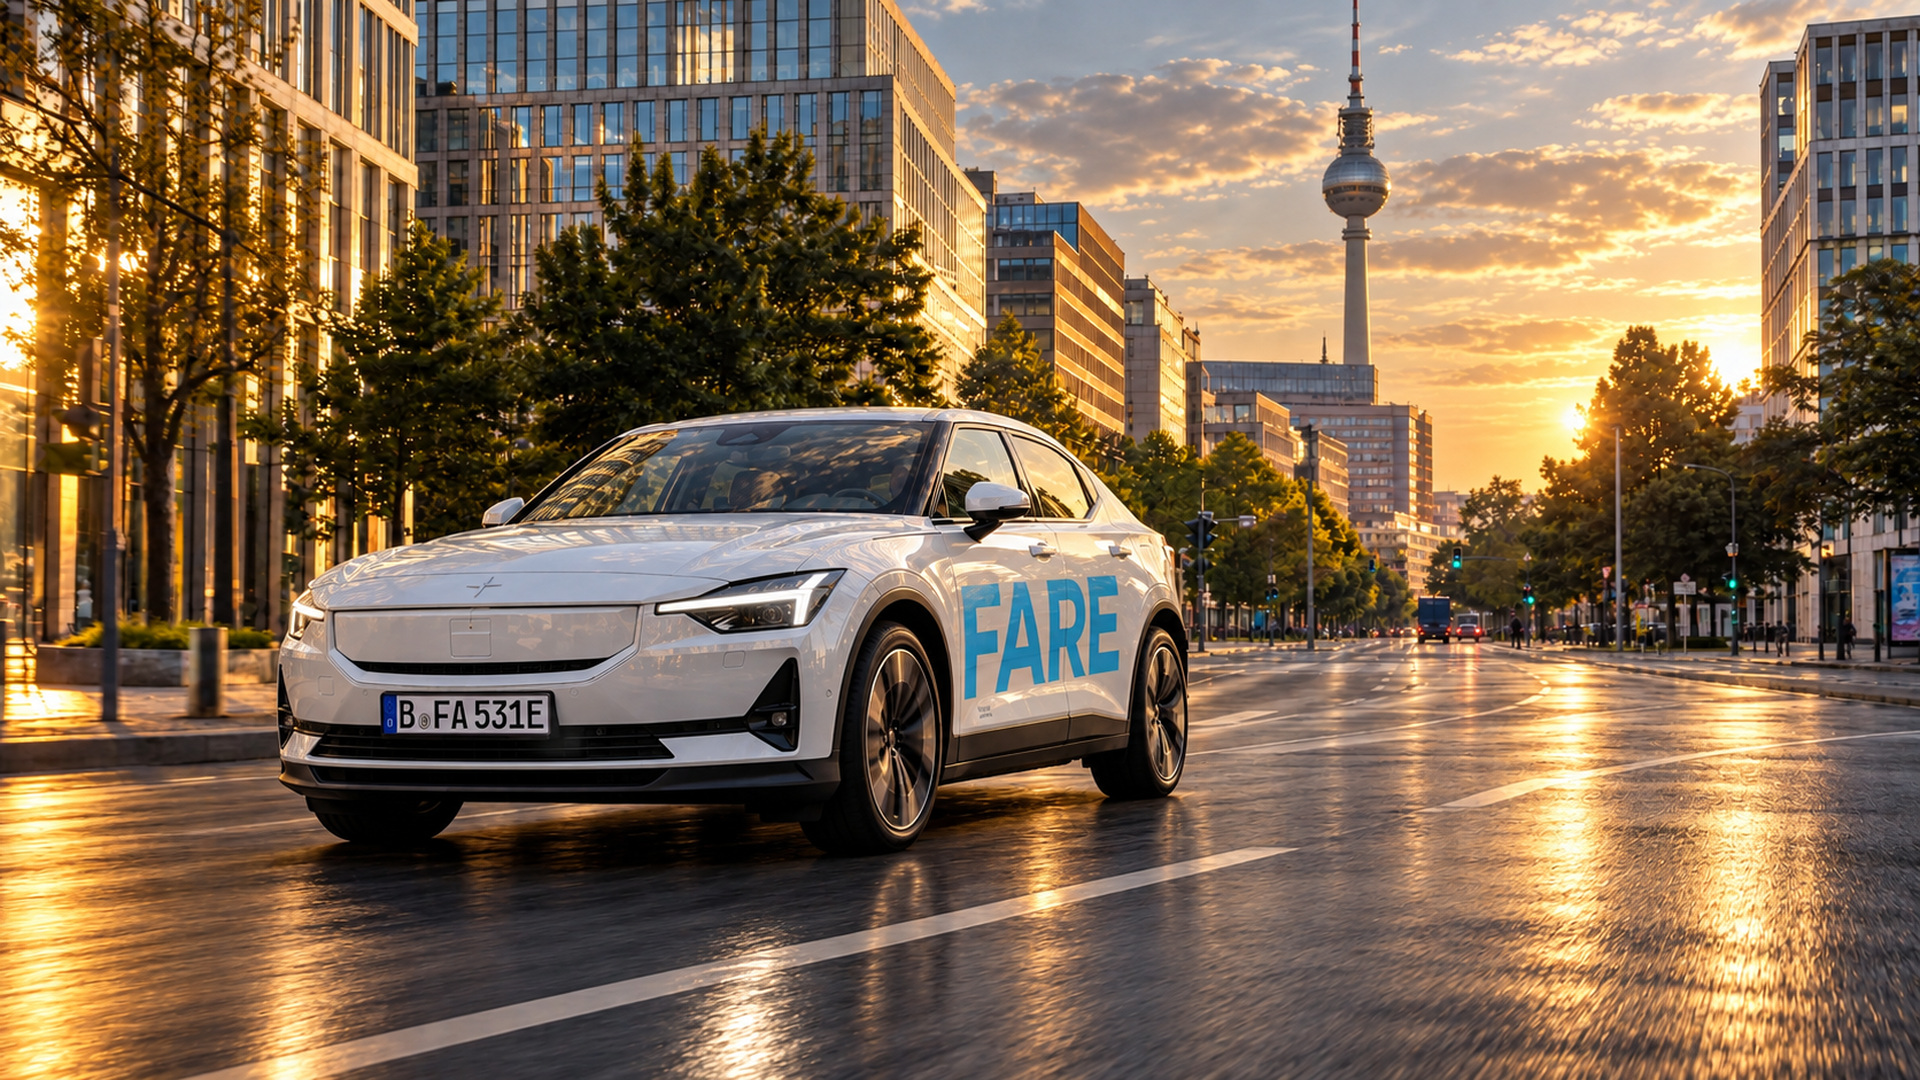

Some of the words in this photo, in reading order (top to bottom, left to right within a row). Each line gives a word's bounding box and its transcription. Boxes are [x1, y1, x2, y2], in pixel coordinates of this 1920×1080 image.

[961, 575, 1119, 700] FARE
[399, 700, 415, 729] B
[434, 700, 468, 729] FA
[475, 700, 545, 729] 531E
